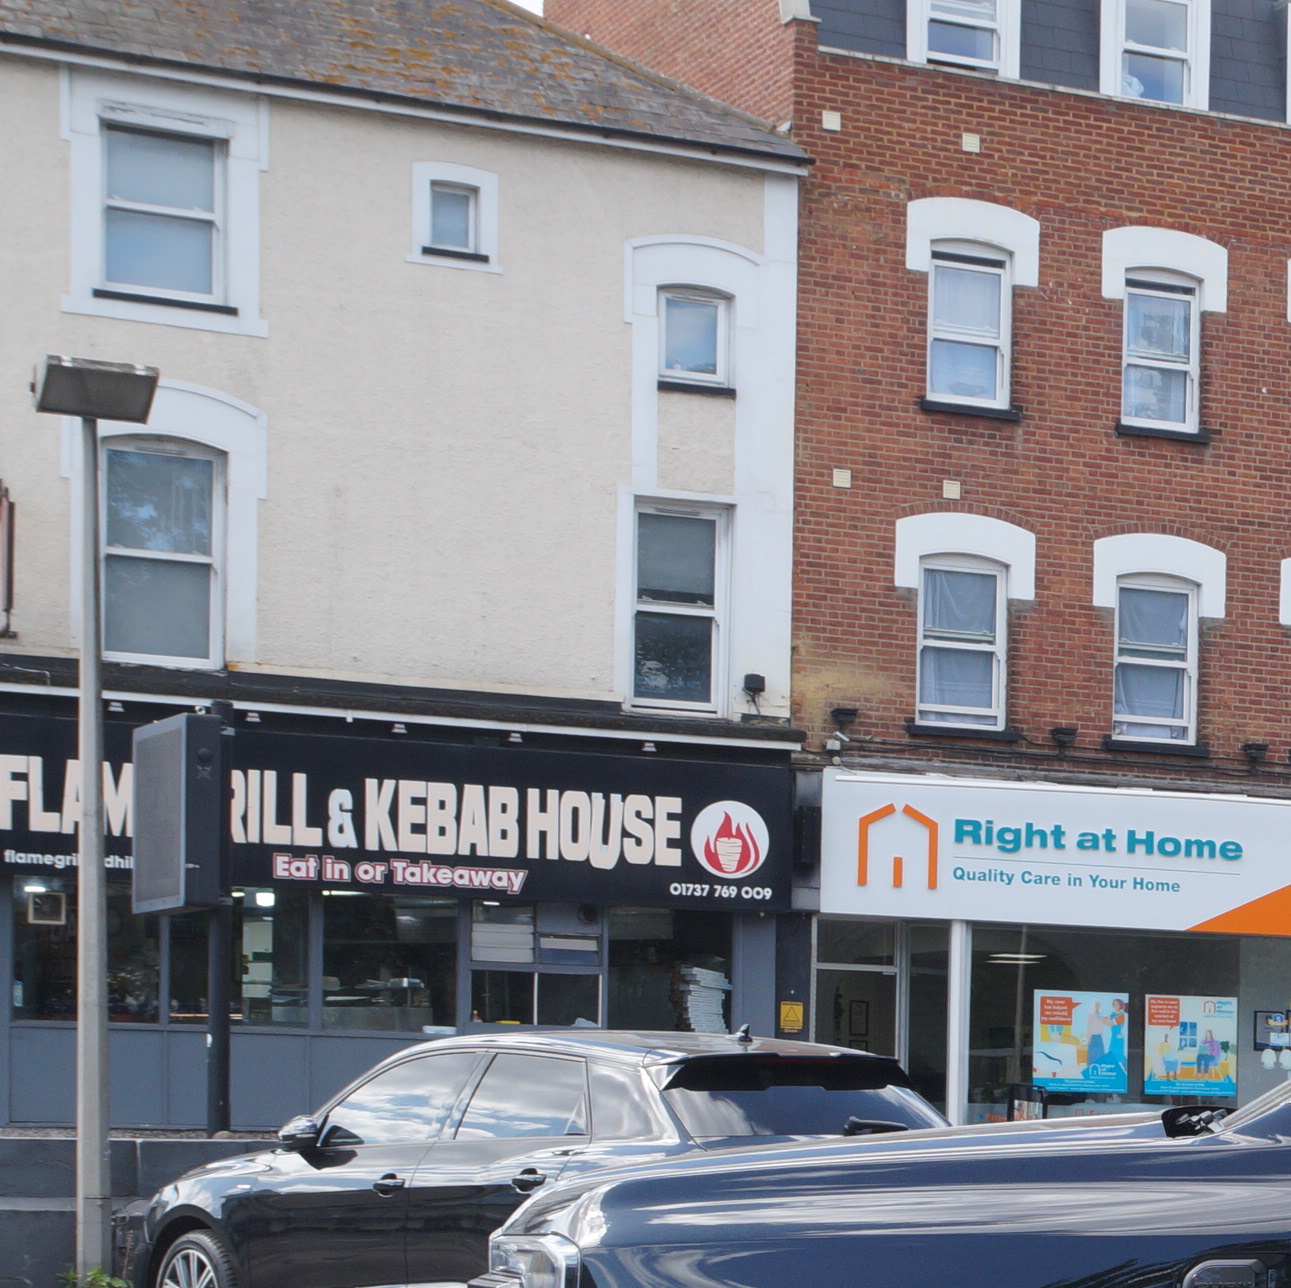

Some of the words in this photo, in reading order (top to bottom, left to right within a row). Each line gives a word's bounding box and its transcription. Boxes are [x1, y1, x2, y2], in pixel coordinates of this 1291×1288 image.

[0, 754, 133, 838] FLAM
[231, 769, 323, 848] RILL
[328, 788, 358, 849] &
[364, 778, 519, 858] KEBAB
[526, 787, 682, 870] HOUSE
[954, 818, 1066, 854] Right
[1076, 828, 1116, 852] at
[1126, 829, 1244, 862] Home
[273, 852, 319, 880] Eat
[322, 855, 351, 883] in
[355, 861, 388, 884] or
[390, 858, 529, 895] Takeaway
[669, 882, 709, 897] 01737
[713, 885, 737, 899] 769
[741, 886, 772, 900] 009
[953, 866, 1015, 886] Quality
[1020, 870, 1061, 887] Care
[1067, 873, 1082, 887] in
[1088, 874, 1127, 890] Your
[1132, 877, 1181, 893] Home
